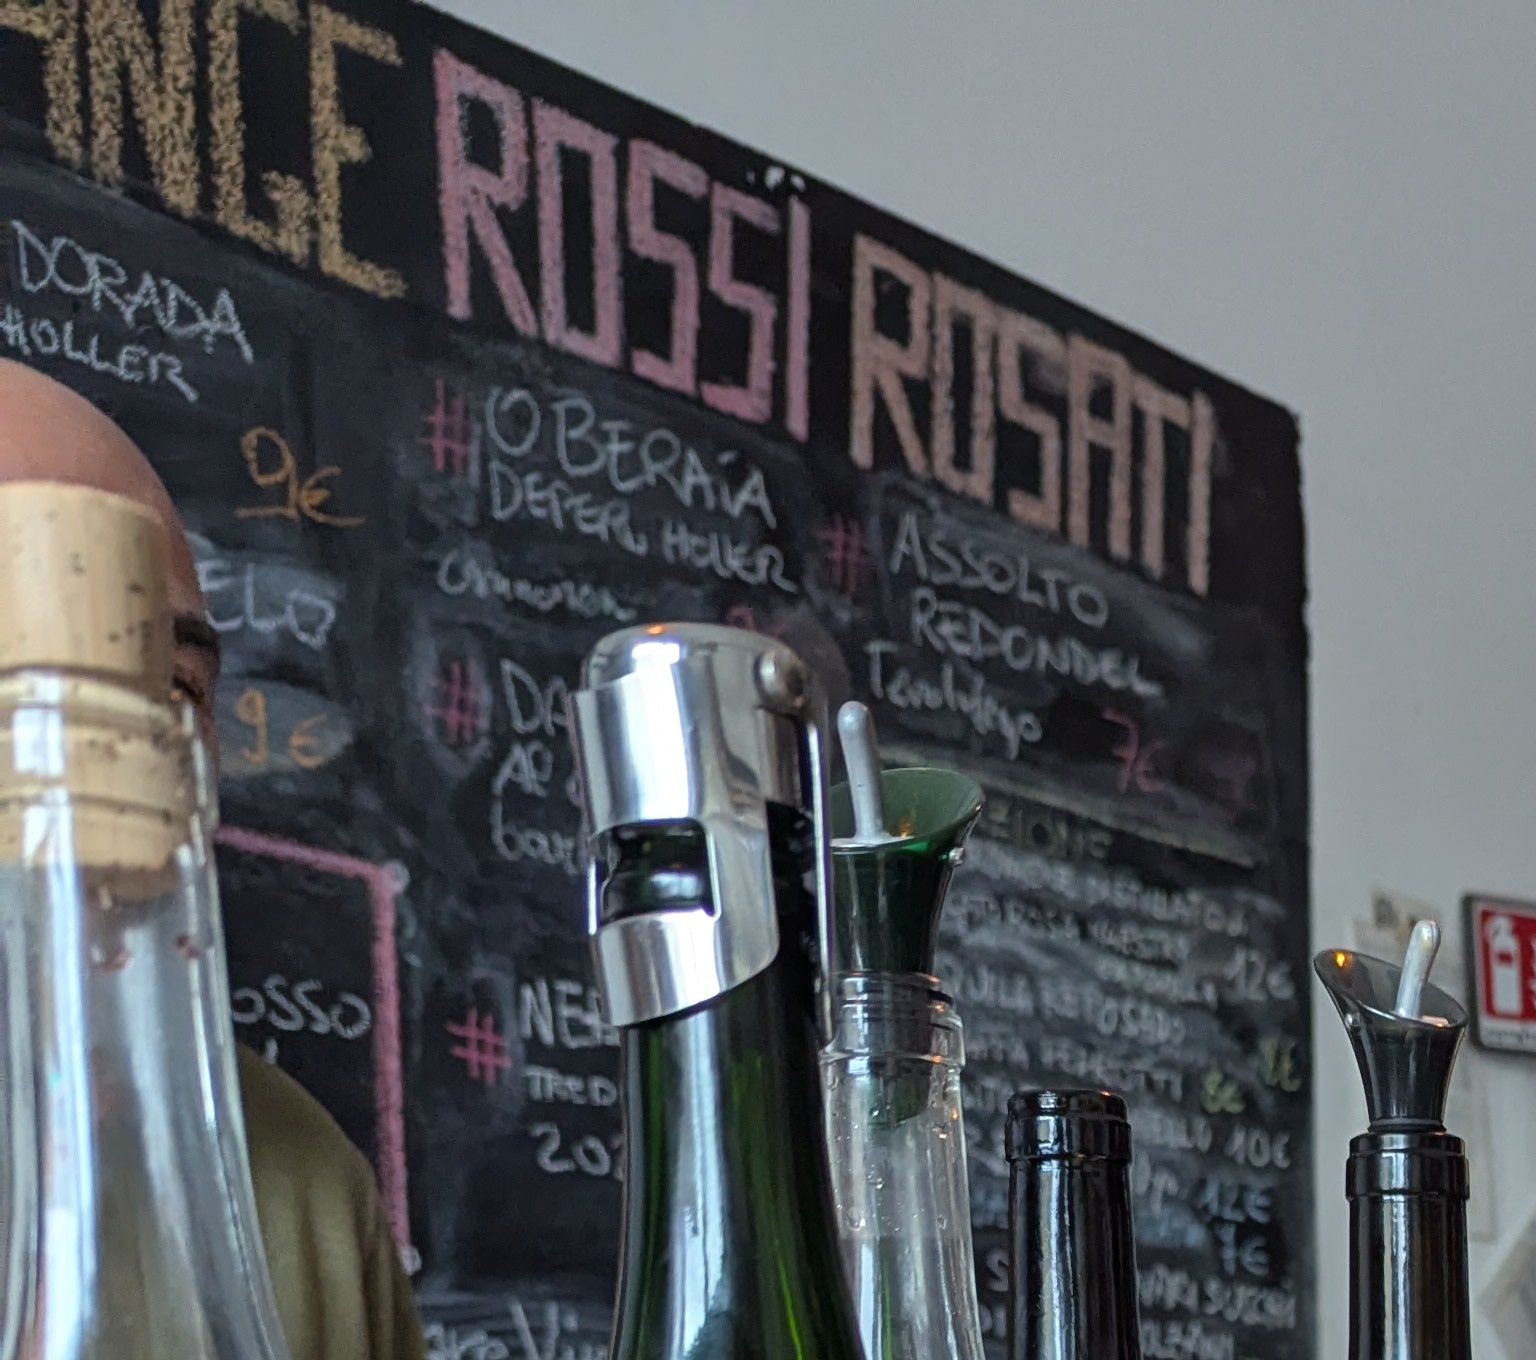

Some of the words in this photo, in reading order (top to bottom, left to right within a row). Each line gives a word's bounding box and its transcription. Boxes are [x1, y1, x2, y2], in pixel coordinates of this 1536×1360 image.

[10, 218, 255, 365] DORADA
[851, 233, 1213, 597] ROSATI
[889, 510, 1110, 628] ASSOLTO
